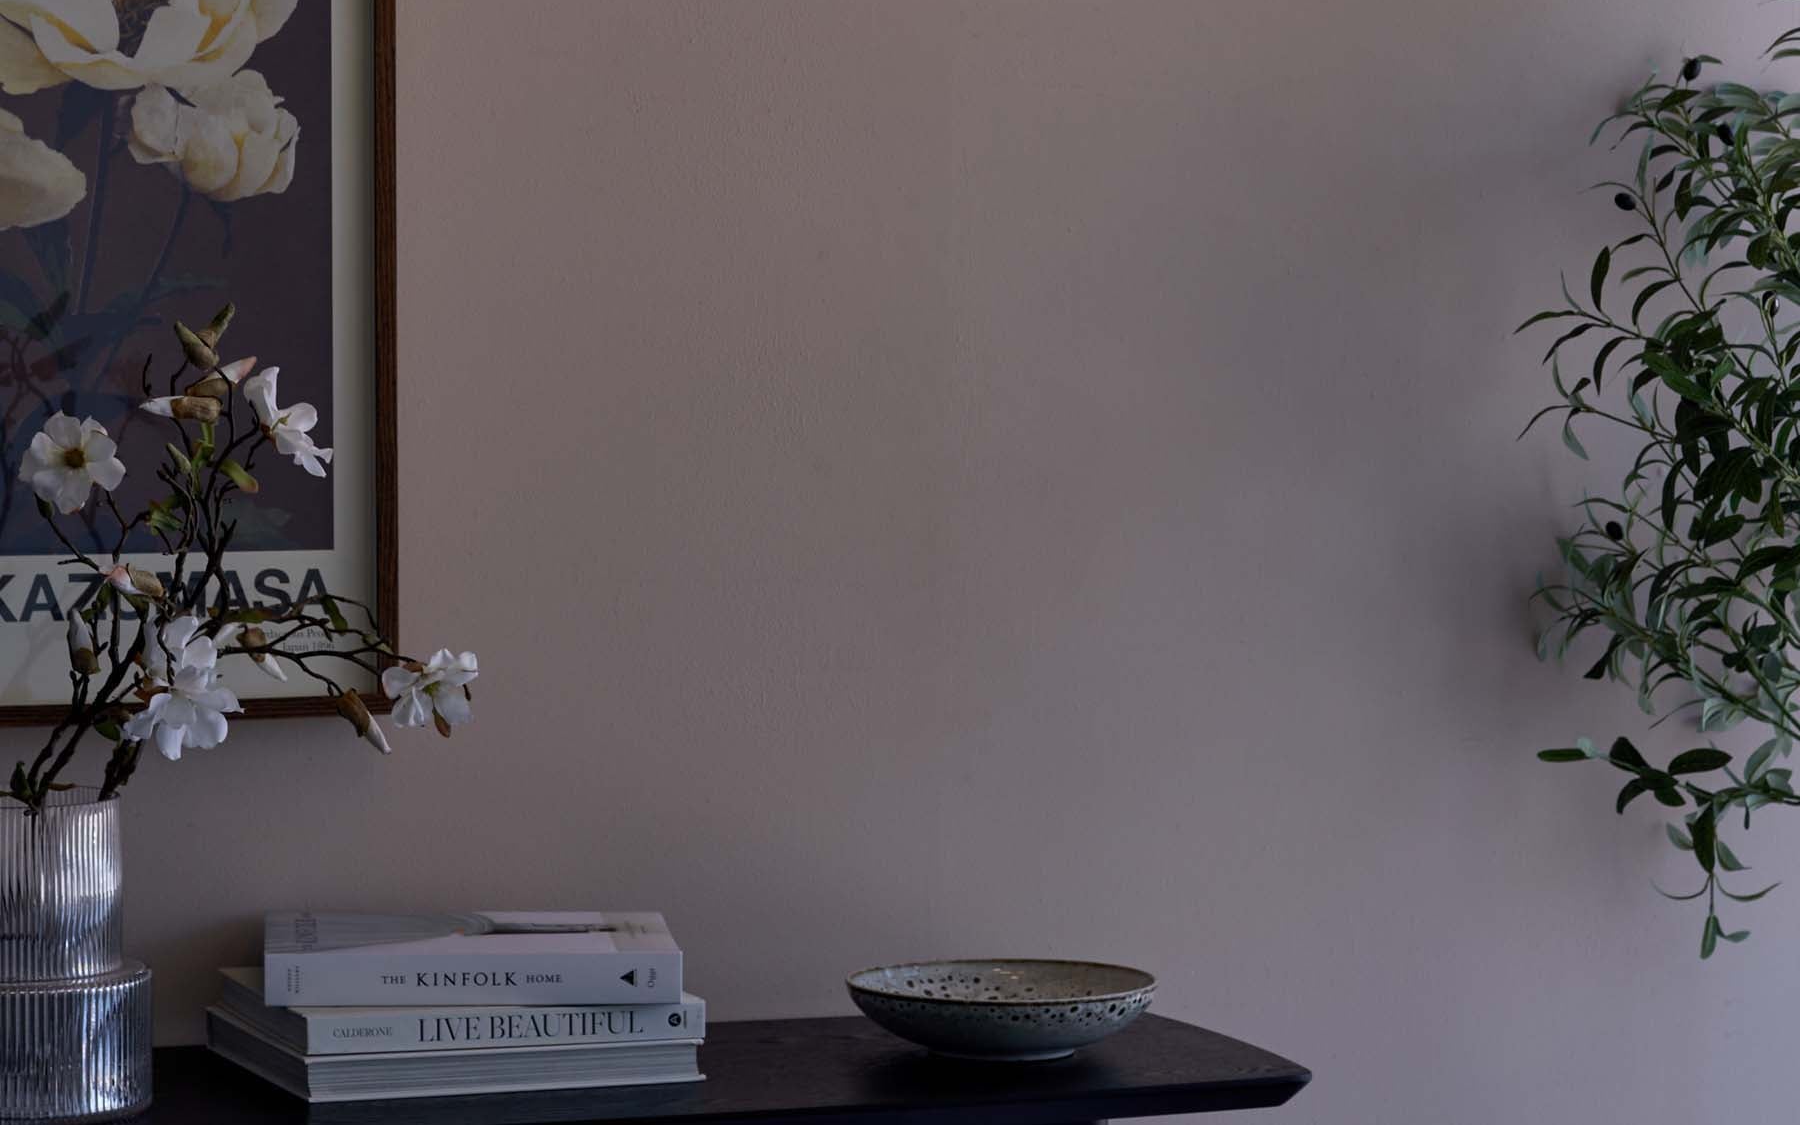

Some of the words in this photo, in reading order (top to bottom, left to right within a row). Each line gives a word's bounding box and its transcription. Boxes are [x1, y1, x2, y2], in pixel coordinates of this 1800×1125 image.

[381, 975, 407, 985] THE
[416, 972, 518, 987] KINFOLK
[526, 974, 563, 984] HOME
[332, 1026, 393, 1039] CALDERONE
[418, 1016, 481, 1043] LIVE
[489, 1010, 645, 1041] BEAUTIFUL
